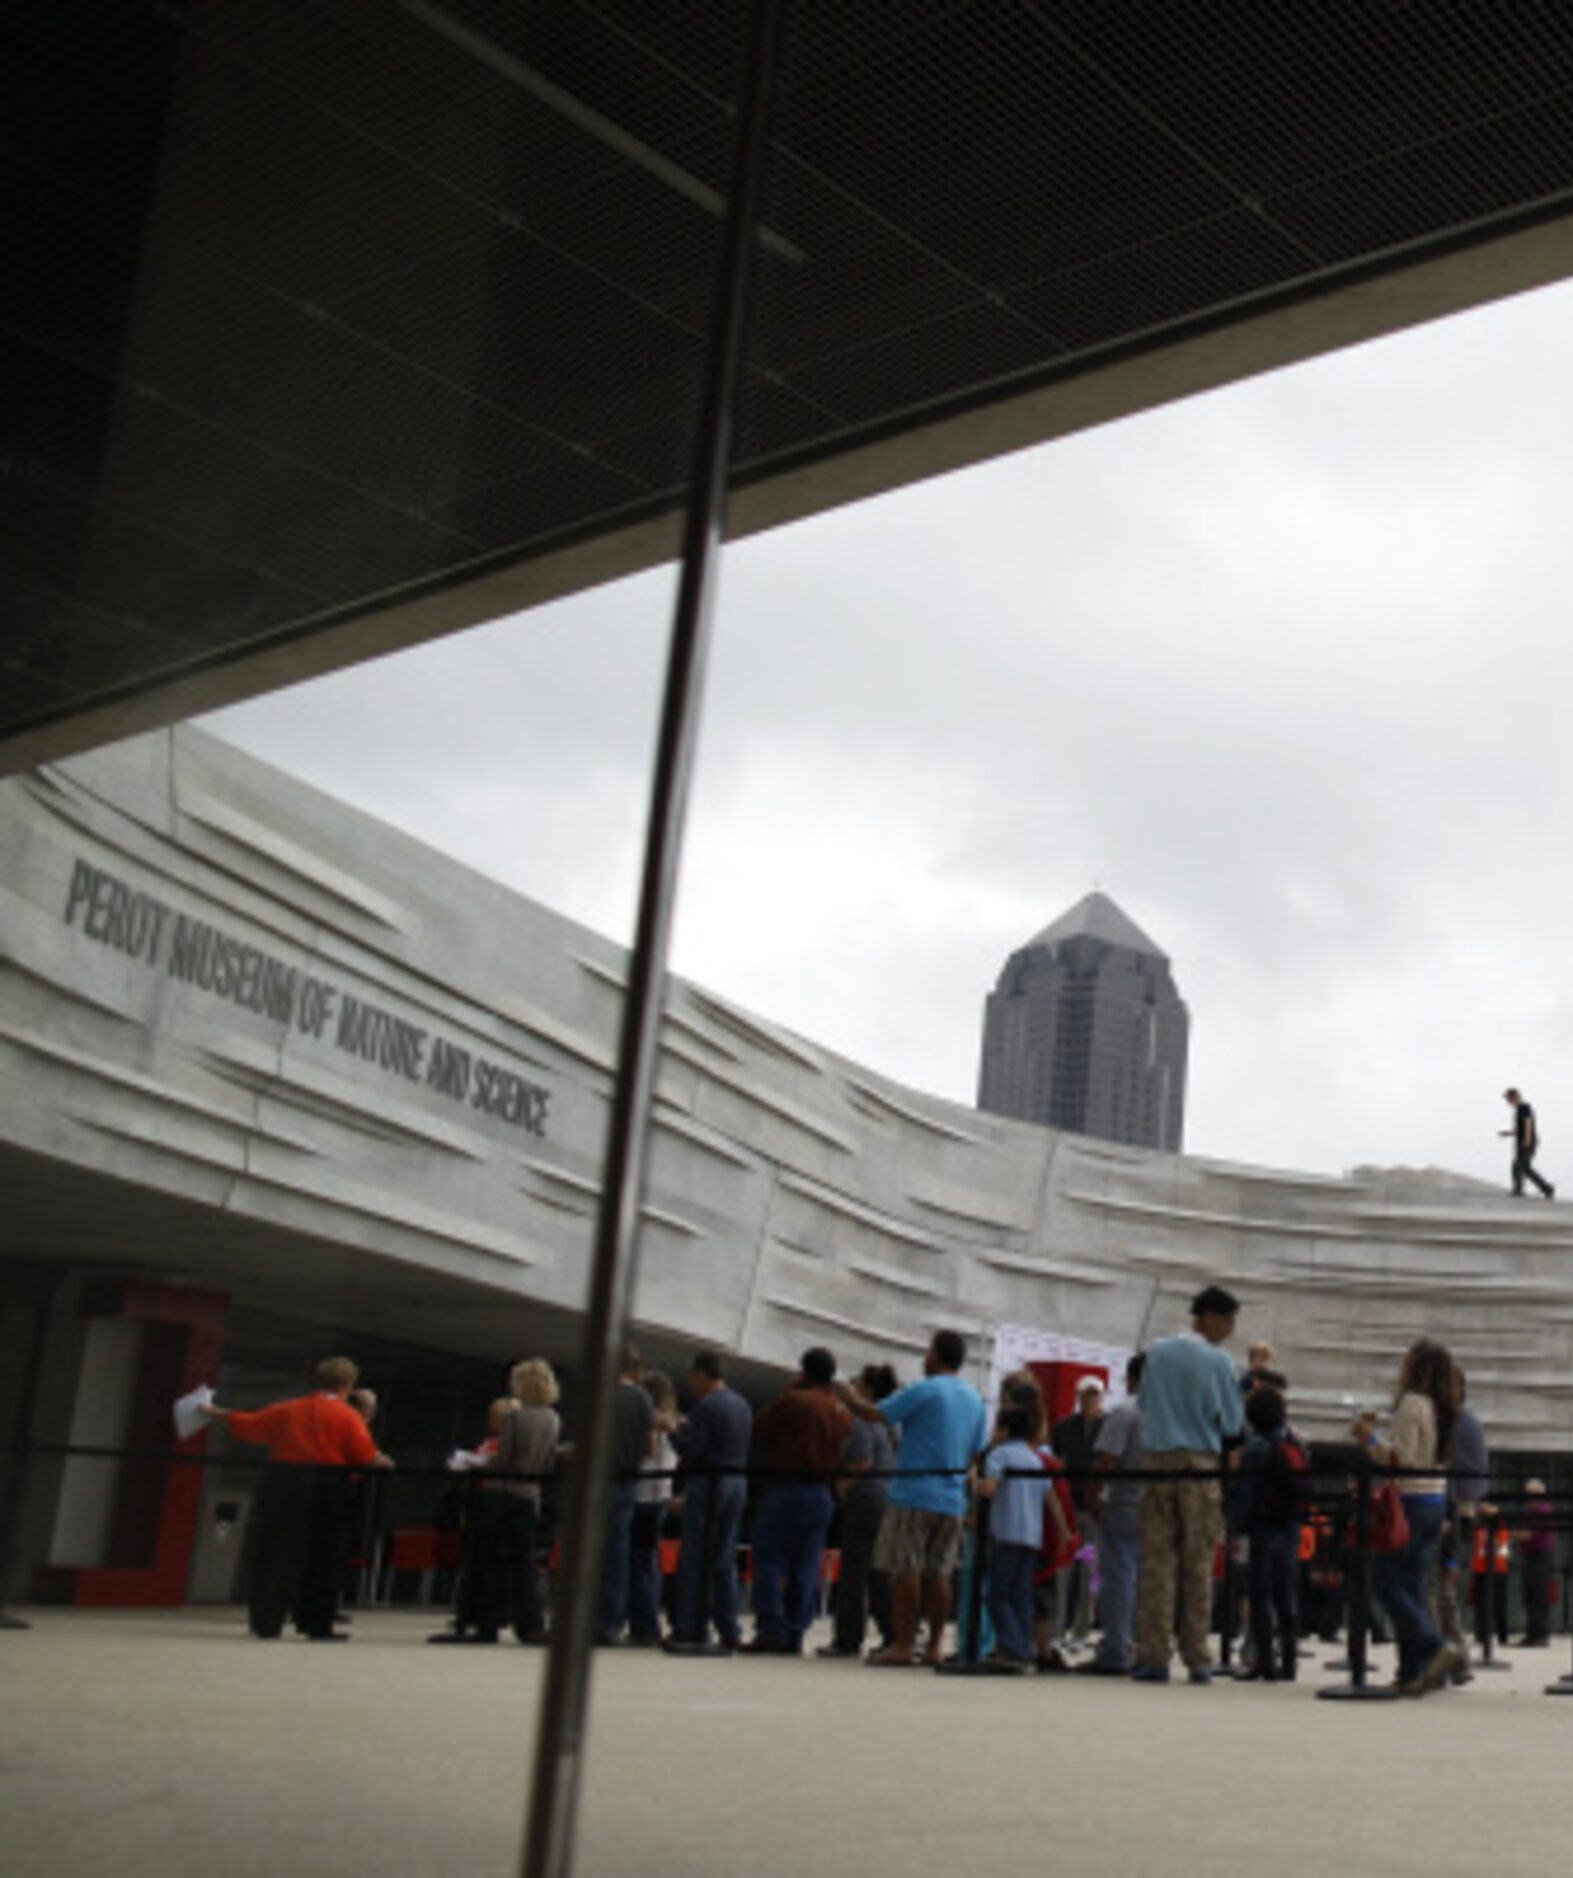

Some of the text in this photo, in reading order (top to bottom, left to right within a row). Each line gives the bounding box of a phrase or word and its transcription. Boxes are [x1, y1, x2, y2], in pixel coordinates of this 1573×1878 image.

[65, 858, 550, 1137] PEROT MUSEUM OF NATURE AND SCIENCE
